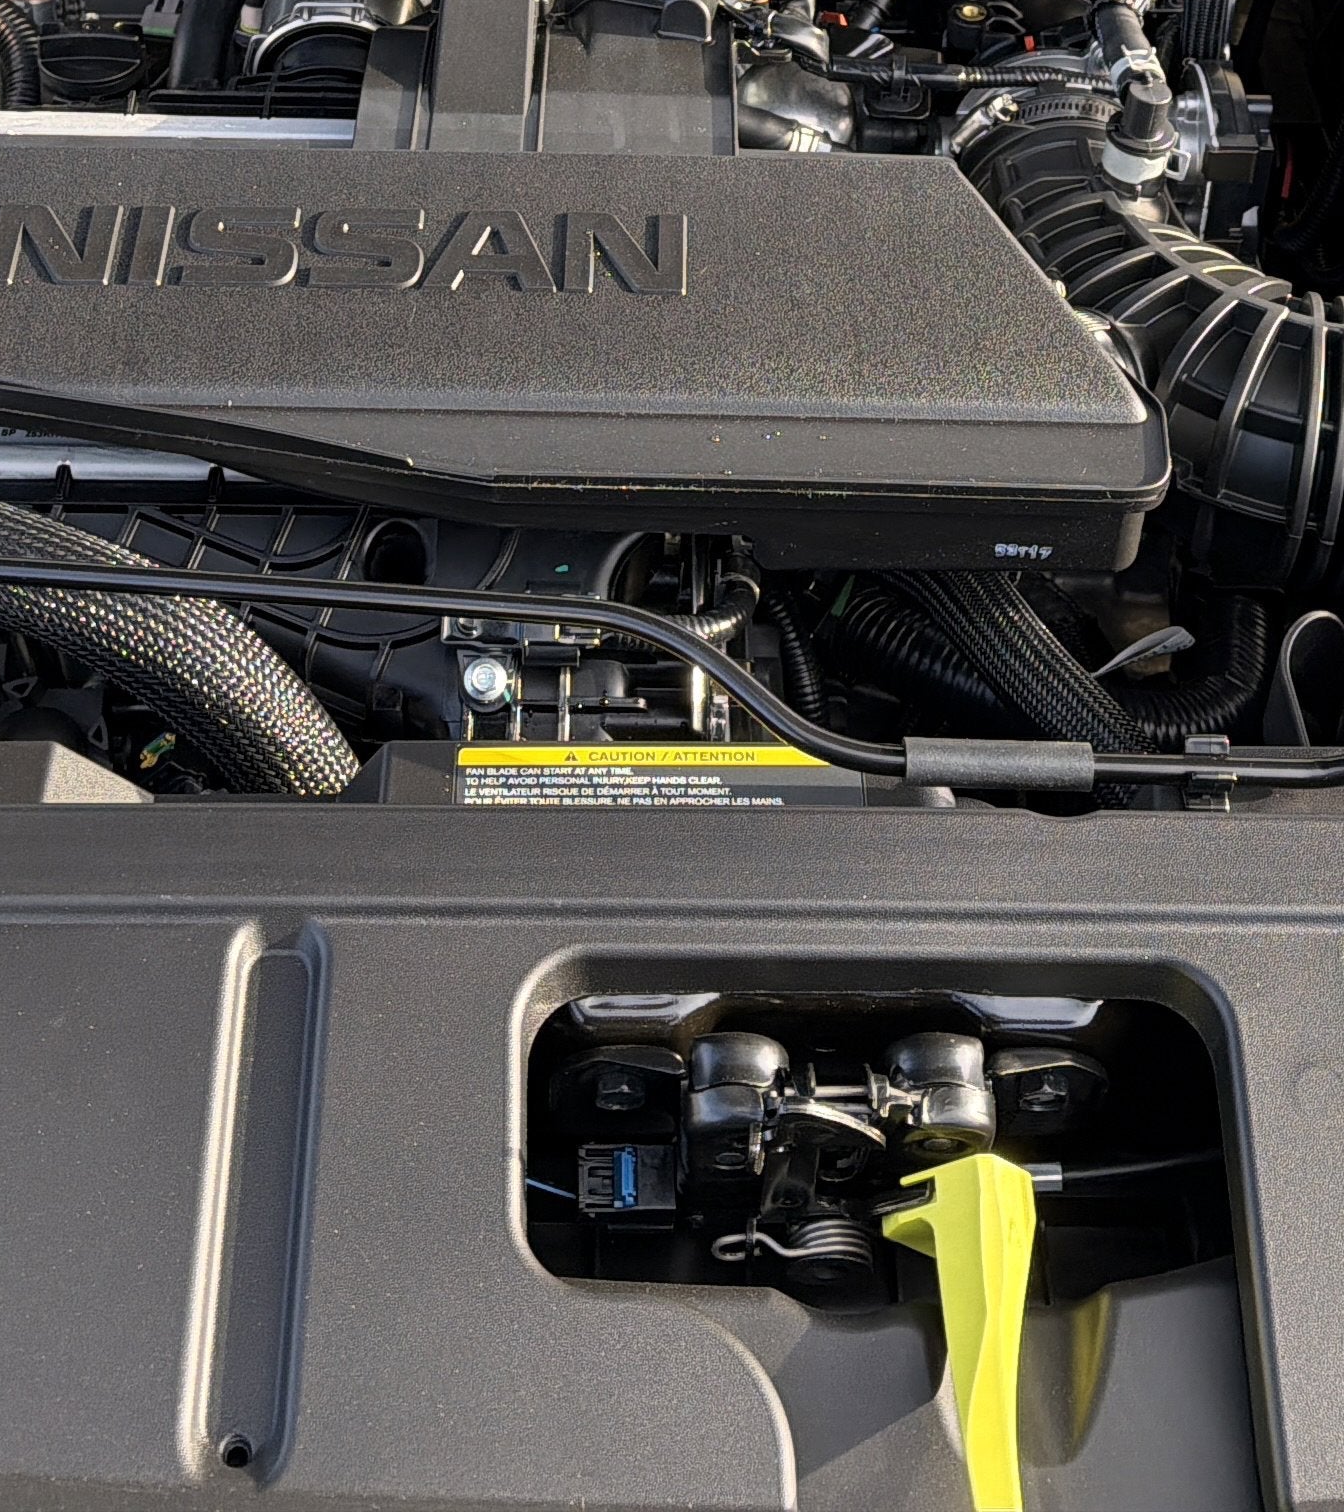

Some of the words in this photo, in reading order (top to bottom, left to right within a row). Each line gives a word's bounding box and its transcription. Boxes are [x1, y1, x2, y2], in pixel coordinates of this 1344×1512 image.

[588, 751, 656, 762] CAUTION
[673, 751, 755, 762] ATTENTION
[466, 767, 484, 776] FAN
[487, 767, 517, 776] BLADE
[520, 767, 541, 776] CAN
[543, 767, 573, 776] START
[575, 767, 588, 776] AT
[588, 767, 608, 776] ANY
[465, 776, 479, 785] TO
[481, 776, 506, 785] HELP
[507, 776, 537, 785] AVOID
[539, 776, 593, 785] PERSONAL
[651, 776, 686, 785] HANDS
[464, 787, 477, 796] LE
[479, 787, 541, 796] VENTILATEUR
[543, 787, 580, 796] RISQUE
[582, 787, 594, 796] DE
[597, 786, 651, 796] DÉMARRER
[660, 787, 686, 796] TOUT
[617, 797, 631, 805] NE
[632, 797, 652, 805] PAS
[654, 797, 668, 805] EN
[669, 797, 729, 805] APPROCHER
[731, 797, 750, 805] LES
